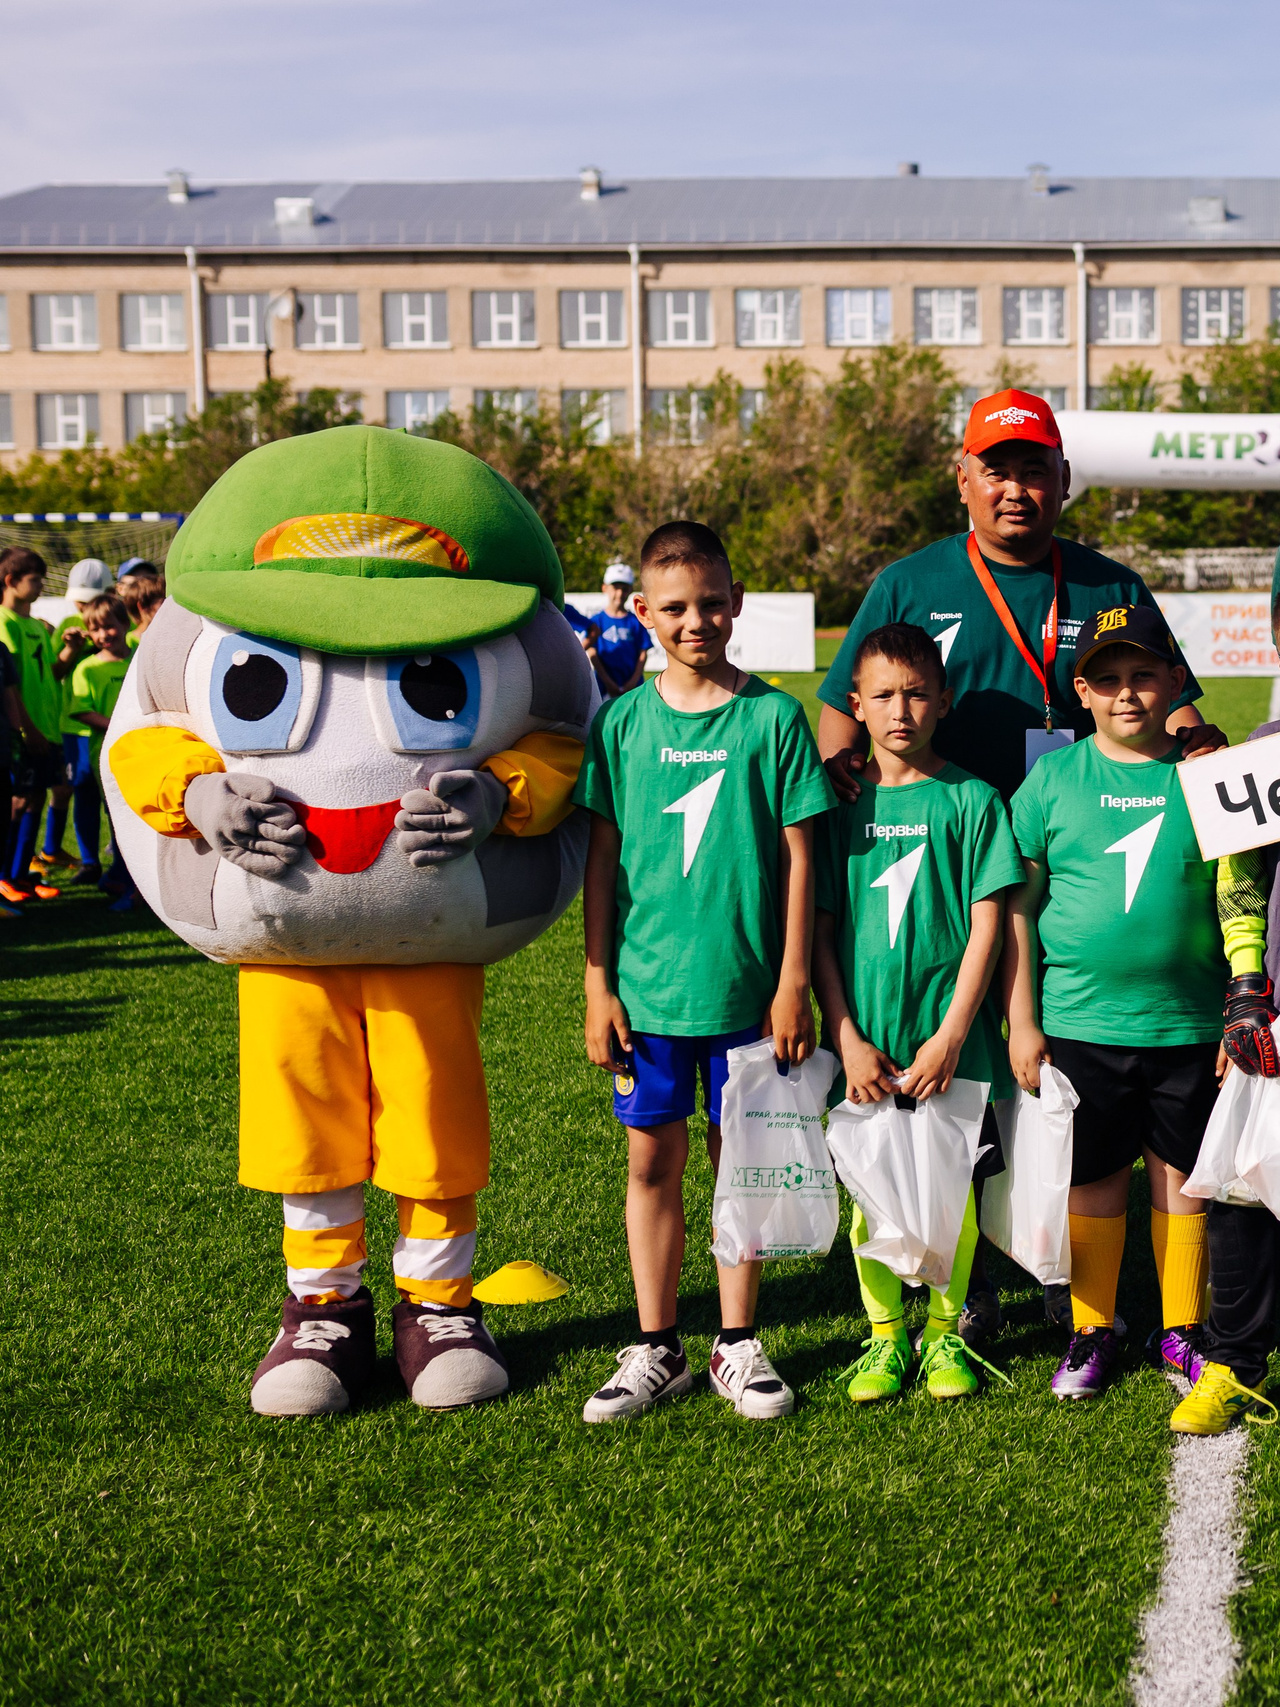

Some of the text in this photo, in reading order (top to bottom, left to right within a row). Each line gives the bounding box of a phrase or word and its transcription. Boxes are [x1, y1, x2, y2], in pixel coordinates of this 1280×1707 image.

[1000, 415, 1025, 426] 2025
[930, 612, 963, 621] Первые
[1211, 604, 1270, 620] ПРИВ
[1211, 626, 1270, 643] УЧАС
[660, 747, 728, 767] Первые
[1100, 794, 1167, 811] Первые
[865, 823, 928, 841] Первые
[745, 1110, 773, 1119] ИГРАЙ,
